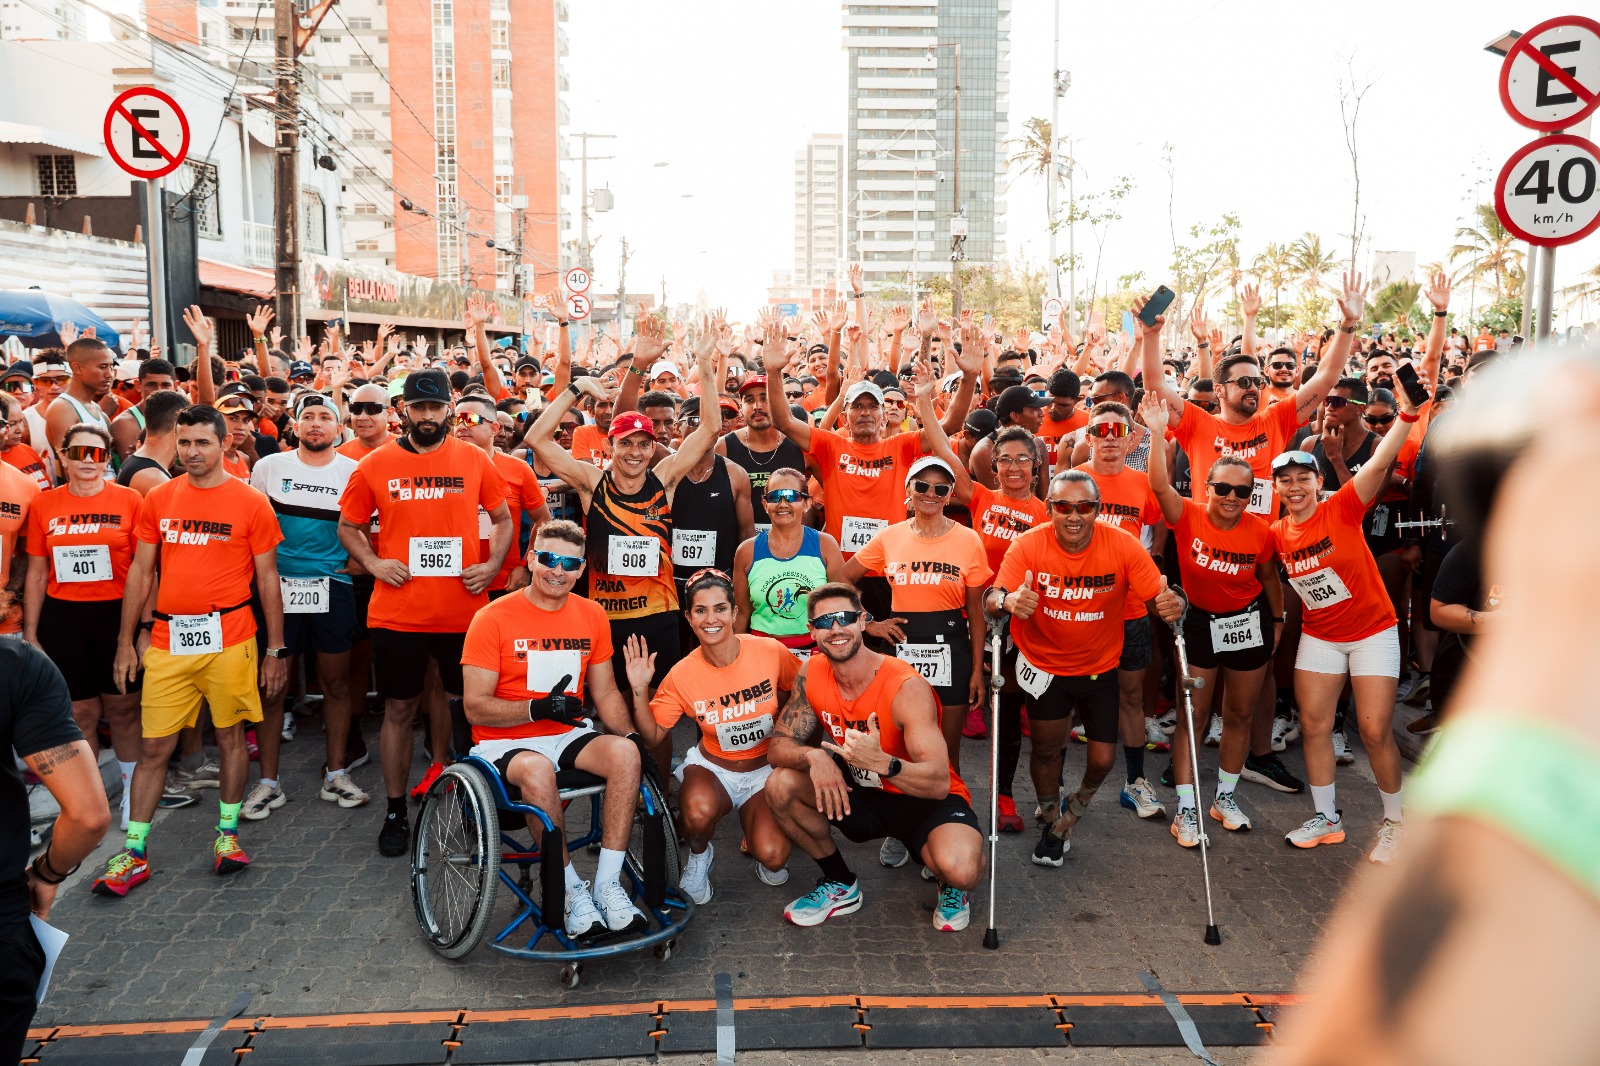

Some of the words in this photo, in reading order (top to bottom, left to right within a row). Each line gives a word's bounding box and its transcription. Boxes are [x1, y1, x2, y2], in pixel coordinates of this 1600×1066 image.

[1536, 40, 1581, 107] E
[131, 109, 162, 159] E
[1515, 157, 1597, 205] 40
[1533, 213, 1574, 224] km/h
[570, 273, 586, 284] 40
[347, 277, 376, 300] BELLA
[1231, 433, 1268, 451] VYBBE
[1232, 448, 1257, 460] RUN
[857, 456, 893, 468] VYBBE
[857, 467, 880, 477] RUN
[292, 483, 338, 495] SPORTS
[414, 477, 464, 488] VYBBE
[415, 488, 444, 500] RUN
[1251, 494, 1262, 507] 81
[0, 501, 21, 515] BE
[70, 514, 121, 524] VYBBE
[67, 524, 100, 534] RUN
[182, 520, 232, 535] VYBBE
[179, 532, 209, 545] RUN
[851, 533, 874, 546] 443
[682, 546, 703, 559] 697
[1292, 536, 1333, 561] VYBBE
[420, 554, 452, 568] 5962
[622, 553, 646, 568] 908
[1212, 548, 1256, 564] VYBBE
[73, 561, 96, 574] 401
[911, 562, 960, 577] VYBBE
[1208, 560, 1239, 575] RUN
[1295, 556, 1320, 574] RUN
[596, 579, 626, 593] PARA
[910, 573, 942, 585] RUN
[1063, 573, 1115, 588] VYBBE
[290, 592, 319, 605] 2200
[1061, 588, 1094, 600] RUN
[1308, 585, 1336, 602] 1634
[1043, 606, 1072, 620] RAFAEL
[179, 631, 211, 646] 3826
[1222, 628, 1252, 644] 4664
[541, 639, 591, 650] VYBBE
[1020, 662, 1037, 685] 701
[719, 679, 772, 707] VYBBE
[722, 700, 756, 721] RUN
[730, 729, 765, 746] 6040
